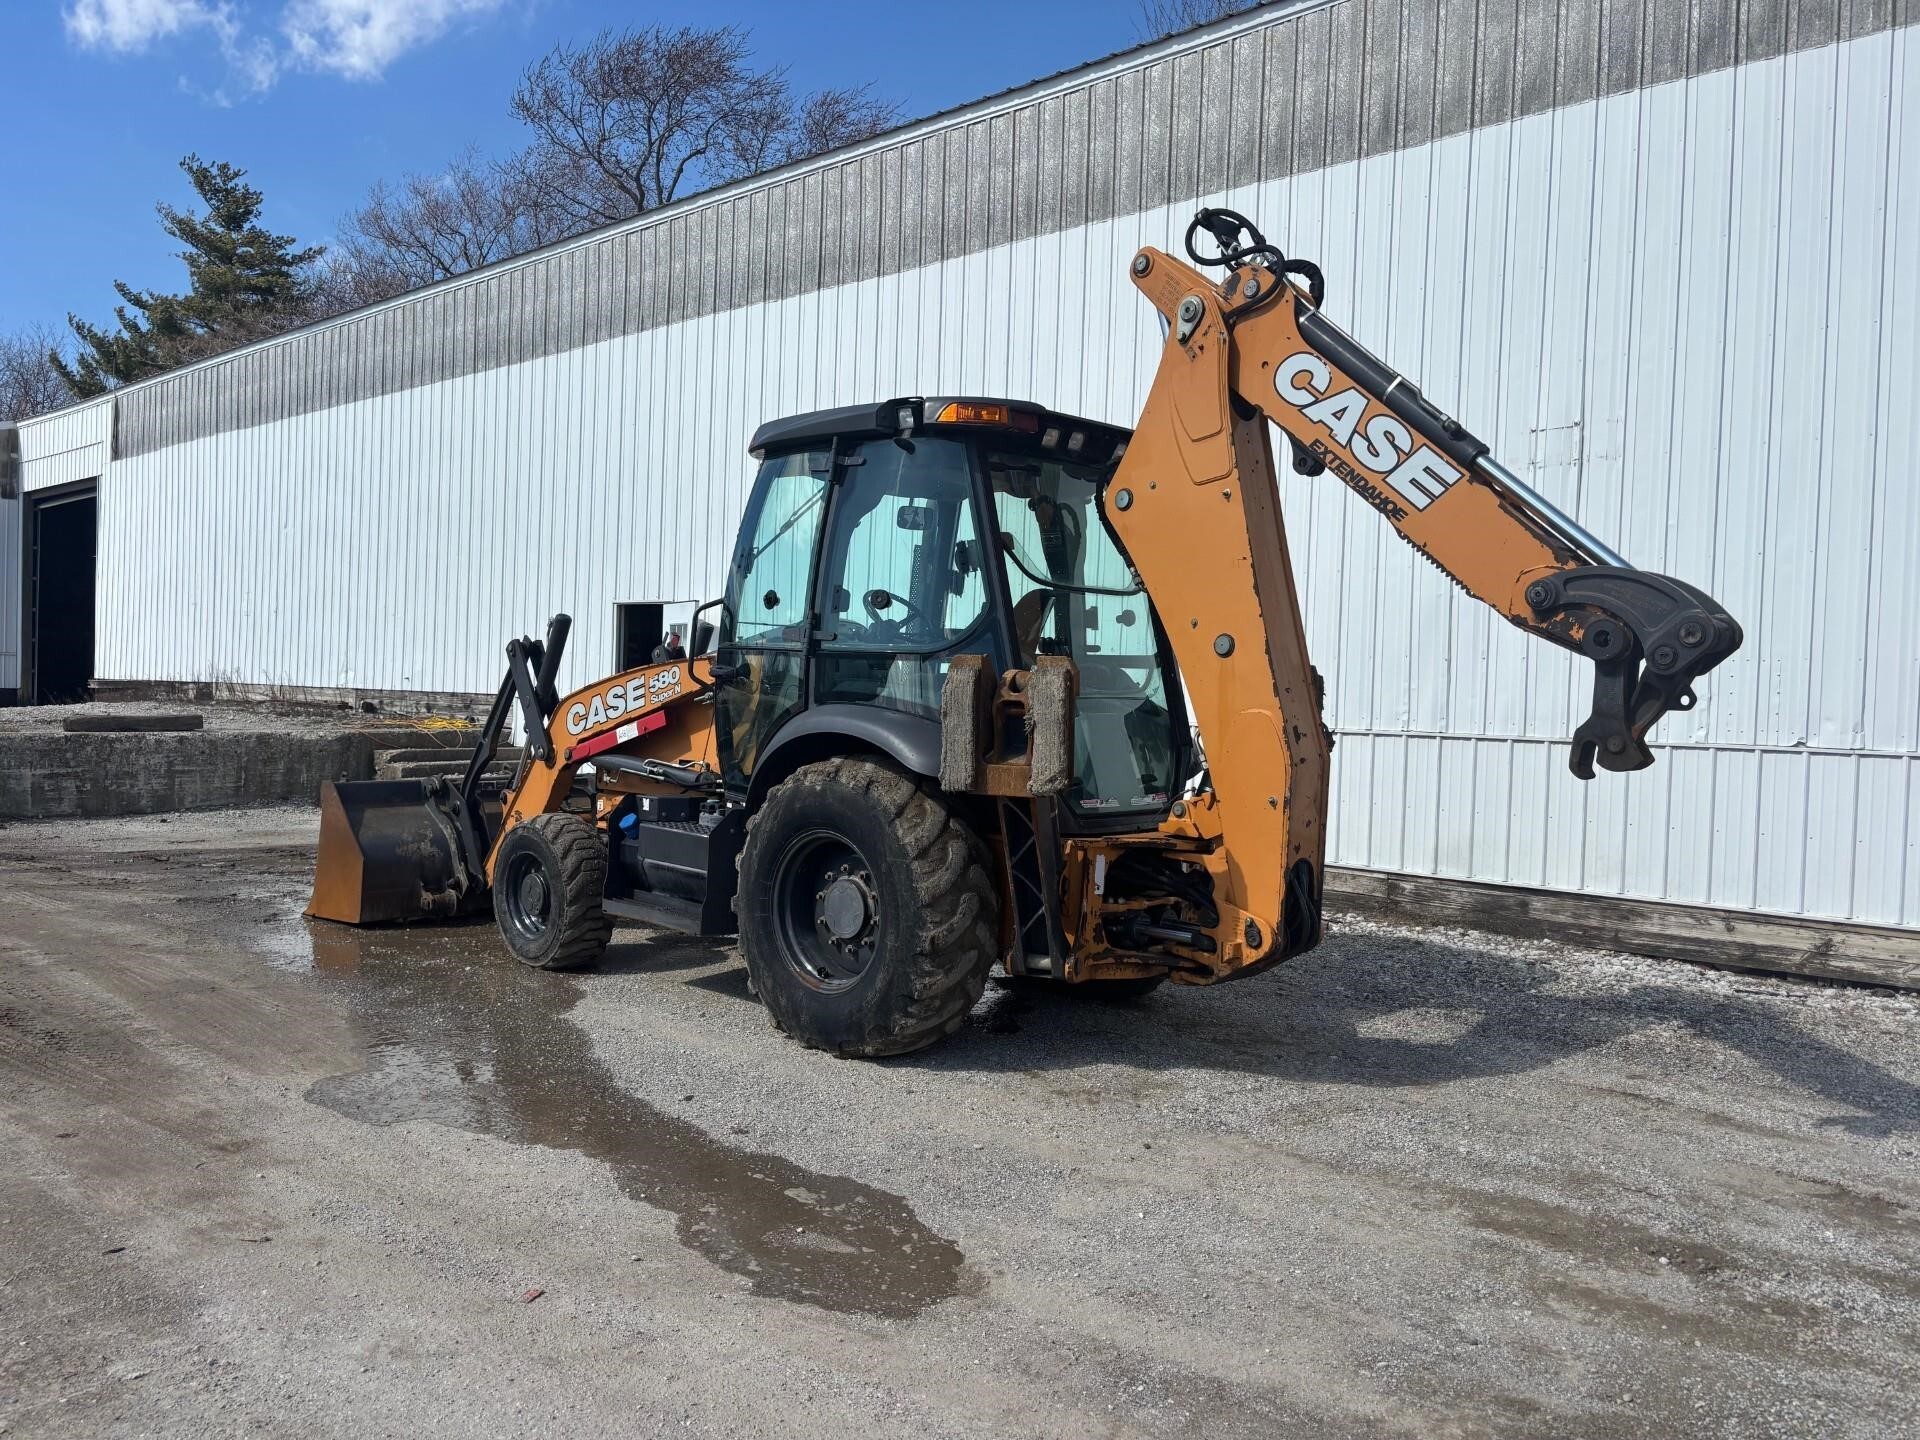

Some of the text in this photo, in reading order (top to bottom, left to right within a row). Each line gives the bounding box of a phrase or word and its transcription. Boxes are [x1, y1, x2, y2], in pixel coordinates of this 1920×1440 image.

[1273, 351, 1466, 512] CASE
[1307, 439, 1409, 523] EXTENDAHOE
[566, 674, 646, 735] CASE
[648, 665, 680, 693] 580
[650, 683, 681, 704] Super N
